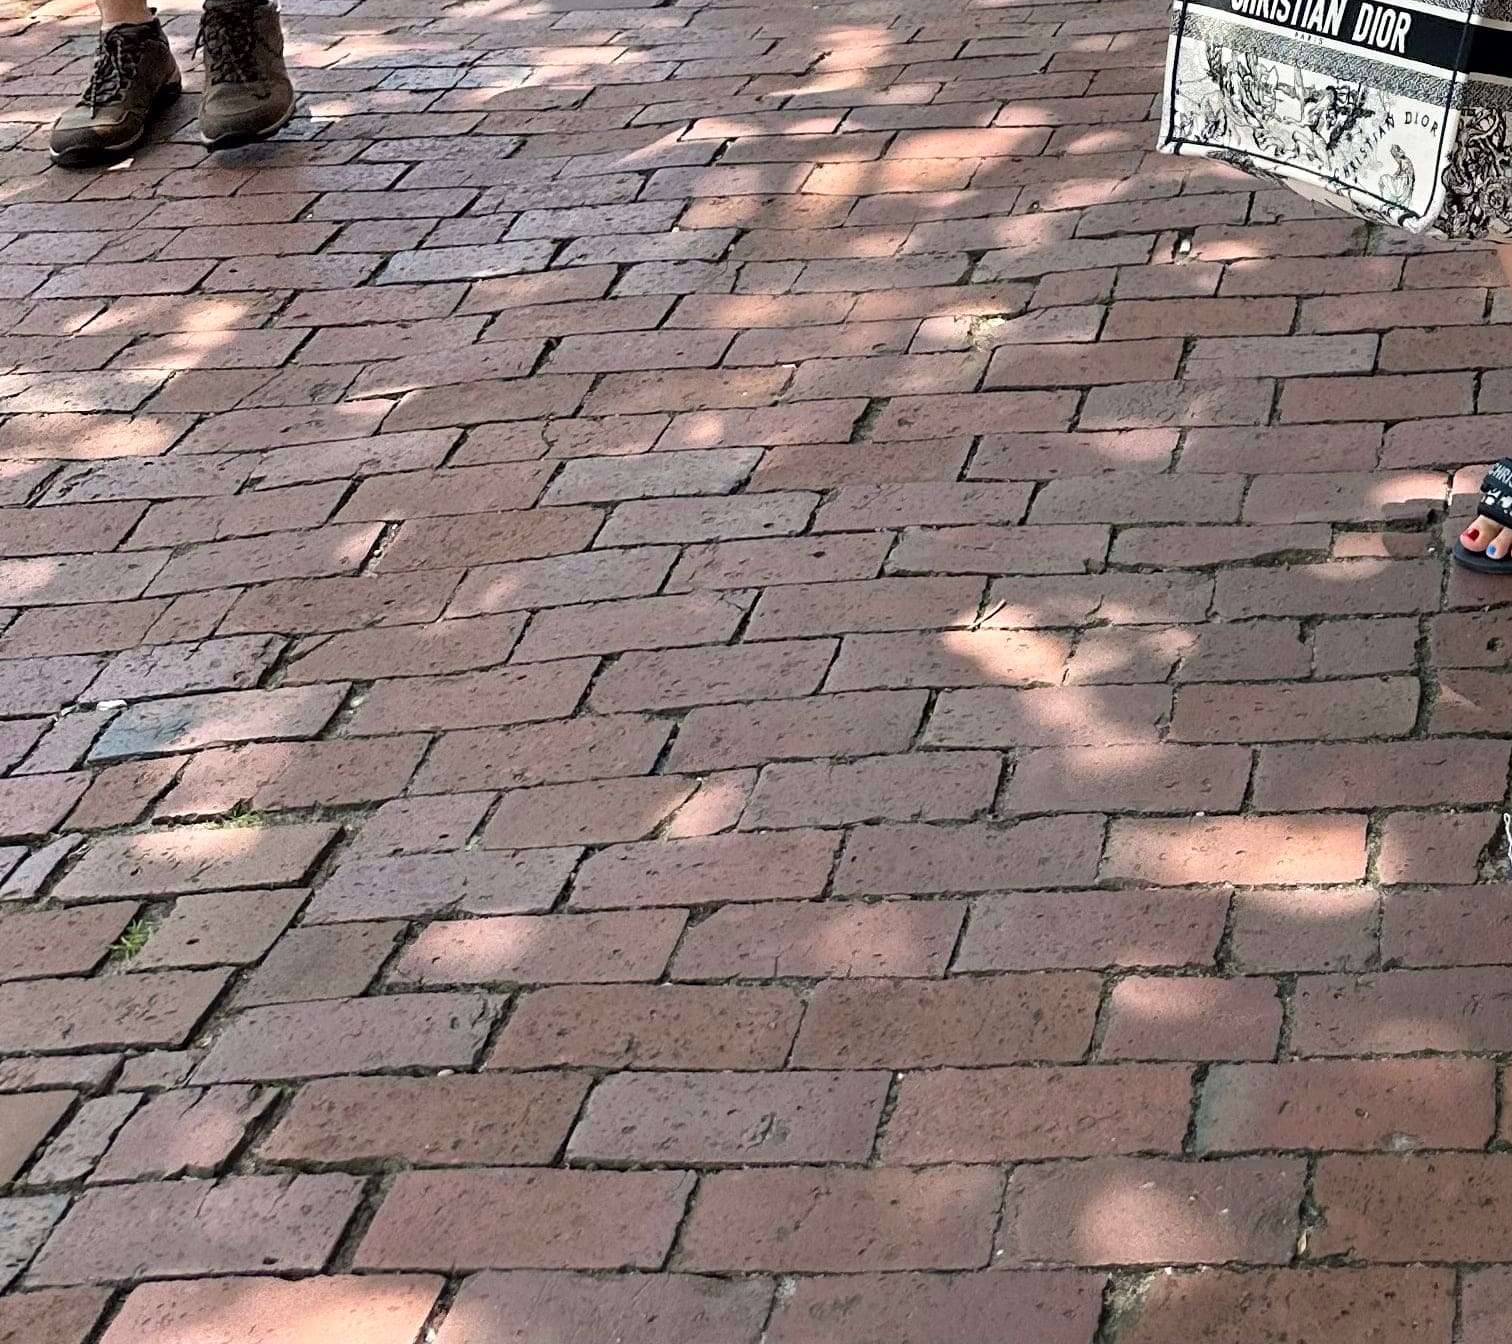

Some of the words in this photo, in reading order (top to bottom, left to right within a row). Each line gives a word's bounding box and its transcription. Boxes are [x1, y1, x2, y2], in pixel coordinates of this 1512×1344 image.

[1294, 31, 1324, 45] PARIS
[1351, 2, 1412, 54] DIOR
[1404, 111, 1438, 137] DIOR
